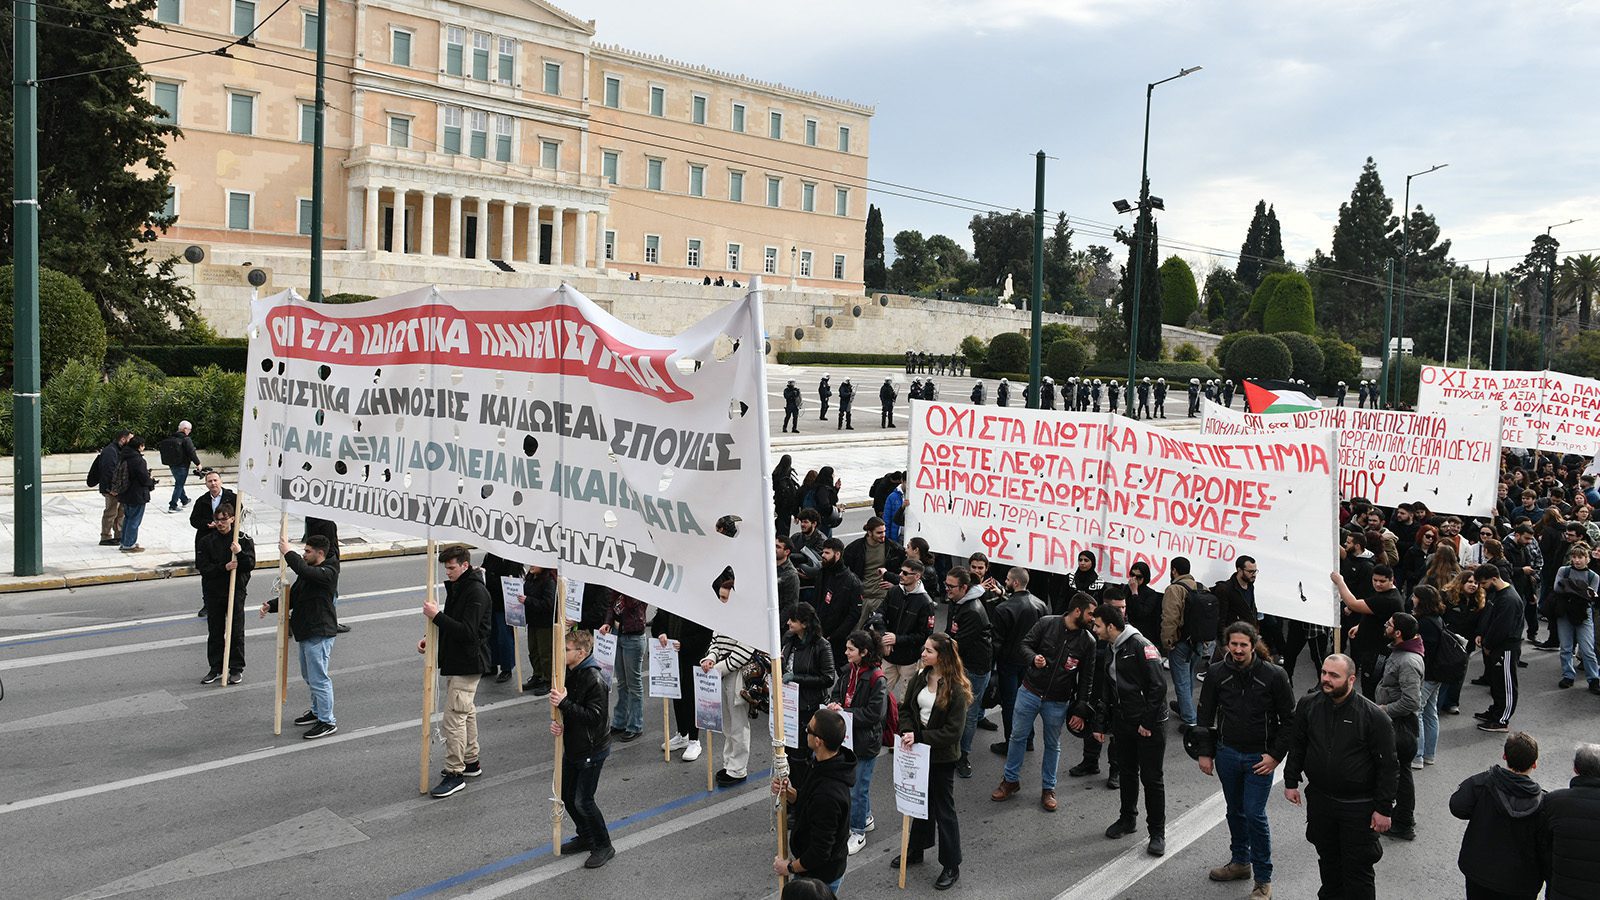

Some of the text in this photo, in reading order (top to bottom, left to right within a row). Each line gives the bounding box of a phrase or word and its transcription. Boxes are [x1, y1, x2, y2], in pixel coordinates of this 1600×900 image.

[272, 316, 675, 393] ΟΙ ΣΤΑ ΙΔΙΩΤΙΚΑ ΠΑΝΕΠΙΣΤΙΑ
[1420, 366, 1467, 388] ΟΧΙ
[1472, 377, 1498, 391] ΣΤΑ
[1502, 377, 1562, 391] ΙΔΙΩΤΙΚΑ
[1442, 388, 1485, 401] ΠΤΥΧΙΑ
[1489, 391, 1504, 401] ΜΕ
[1509, 391, 1537, 401] ΑΞΙΑ
[355, 386, 470, 422] ΔΗΜΟΣΙΕΣ
[479, 393, 517, 428] ΚΑΙ
[610, 418, 741, 471] ΣΠΟΥΔΕΣ
[1244, 408, 1447, 439] ΟΧΙ στα ΙΔΙΩΤΙΚΑ ΠΑΝΕΠΙΣΤΗΜΙΑ
[1499, 400, 1508, 411] &
[1513, 401, 1569, 417] ΔΟΥΛΕΙΑ
[1572, 409, 1591, 420] ΜΕ
[1503, 416, 1518, 427] ΜΕ
[1526, 419, 1550, 430] ΤΟΝ
[305, 429, 333, 458] ΜΕ
[338, 435, 390, 464] ΑΞΙΑ
[408, 440, 507, 484] ΔΟΥΛΕΙΑ
[511, 455, 543, 489] ΜΕ
[925, 405, 1330, 475] ΟΧΙ ΣΤΑ ΙΔΙΩΤΙΚΑ ΠΑΝΕΠΙΣΤΗΜΙΑ
[1411, 436, 1492, 463] ΕΚΠΑΙΔΕΥΣΗ
[920, 442, 993, 471] ΔΩΣΤΕ
[998, 450, 1076, 481] ΛΕΦΤΑ
[1081, 457, 1119, 487] ΓΙΑ
[1389, 454, 1441, 476] ΔΟΥΛΕΙΑ
[289, 475, 409, 521] ΦΟΙΤΗΤΙΚΟΙ
[415, 494, 526, 547] ΣΥΛΛΟΓΟΙ
[923, 492, 1236, 562] ΝΑ ΓΙΝΕΙ ΤΩΡΑ ΕΣΤΙΑ ΣΤΟ ΠΑΝΤΕΙΟ
[1134, 493, 1262, 541] ΣΠΟΥΔΕΣ
[981, 525, 1016, 560] ΦΣ
